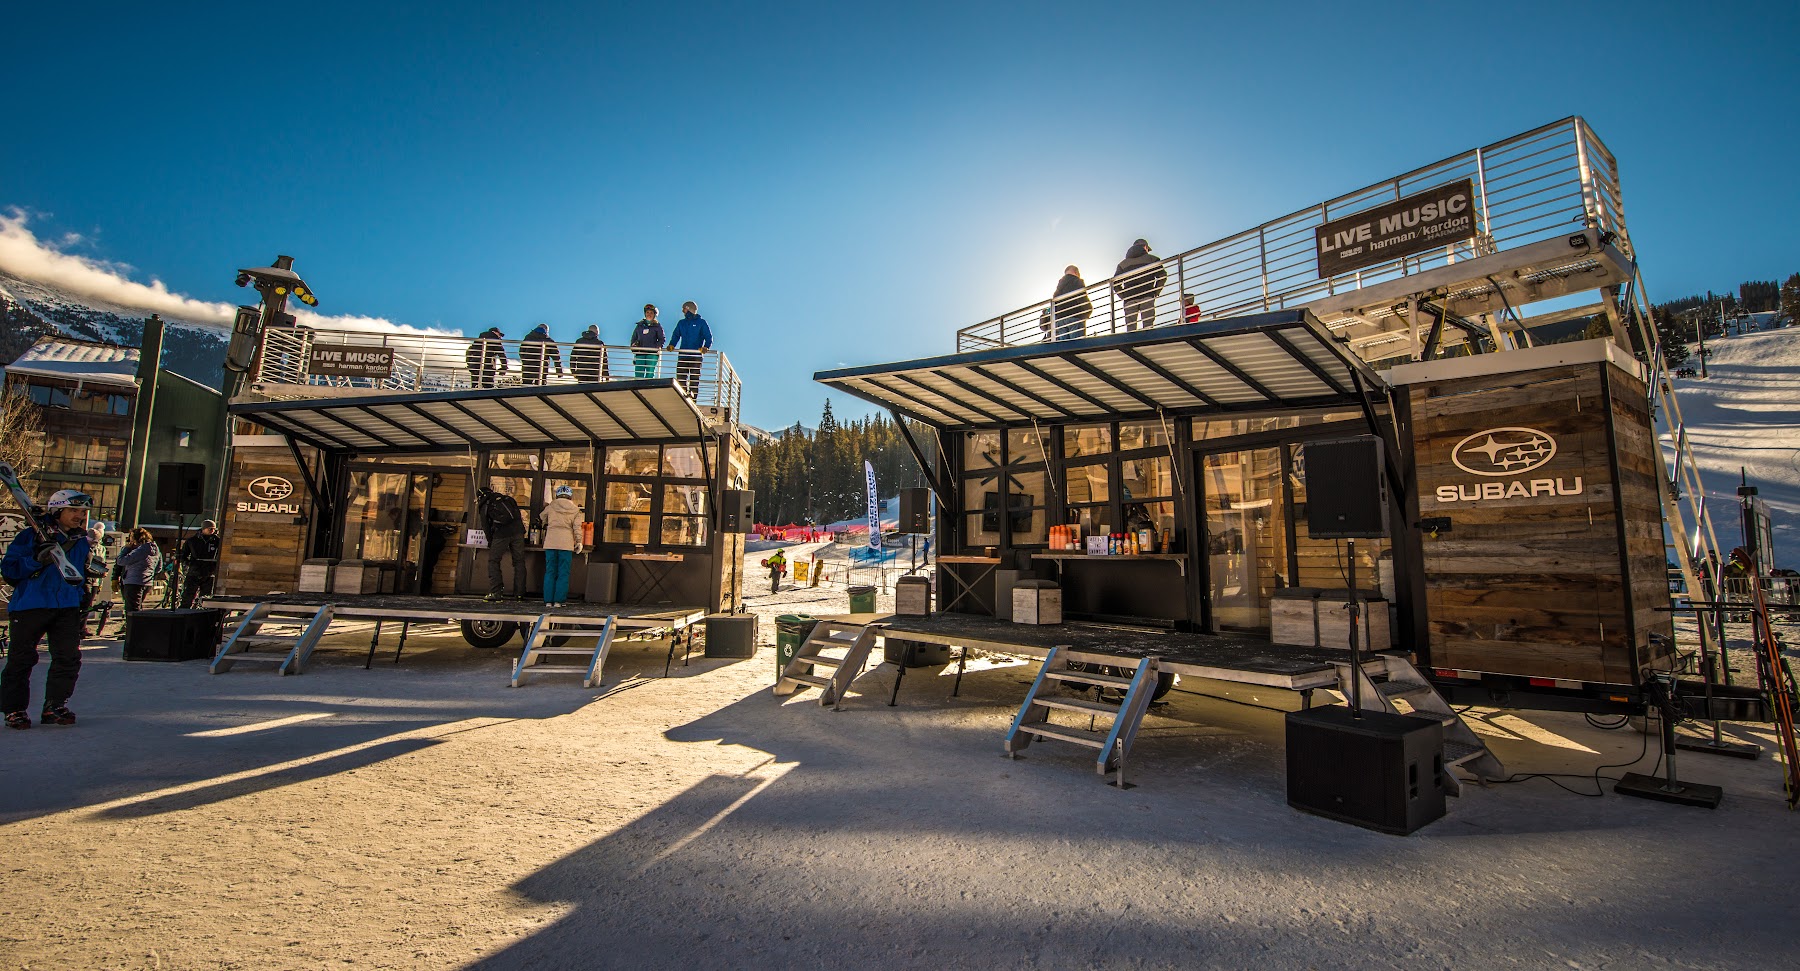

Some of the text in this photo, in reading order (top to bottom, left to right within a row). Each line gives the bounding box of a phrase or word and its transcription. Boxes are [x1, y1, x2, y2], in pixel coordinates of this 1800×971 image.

[1320, 193, 1467, 253] LIVE MUSIC
[1427, 223, 1470, 241] HARMAN
[312, 350, 389, 364] LIVE MUSIC
[1436, 476, 1583, 503] SUBARU
[236, 502, 300, 514] SUBARU
